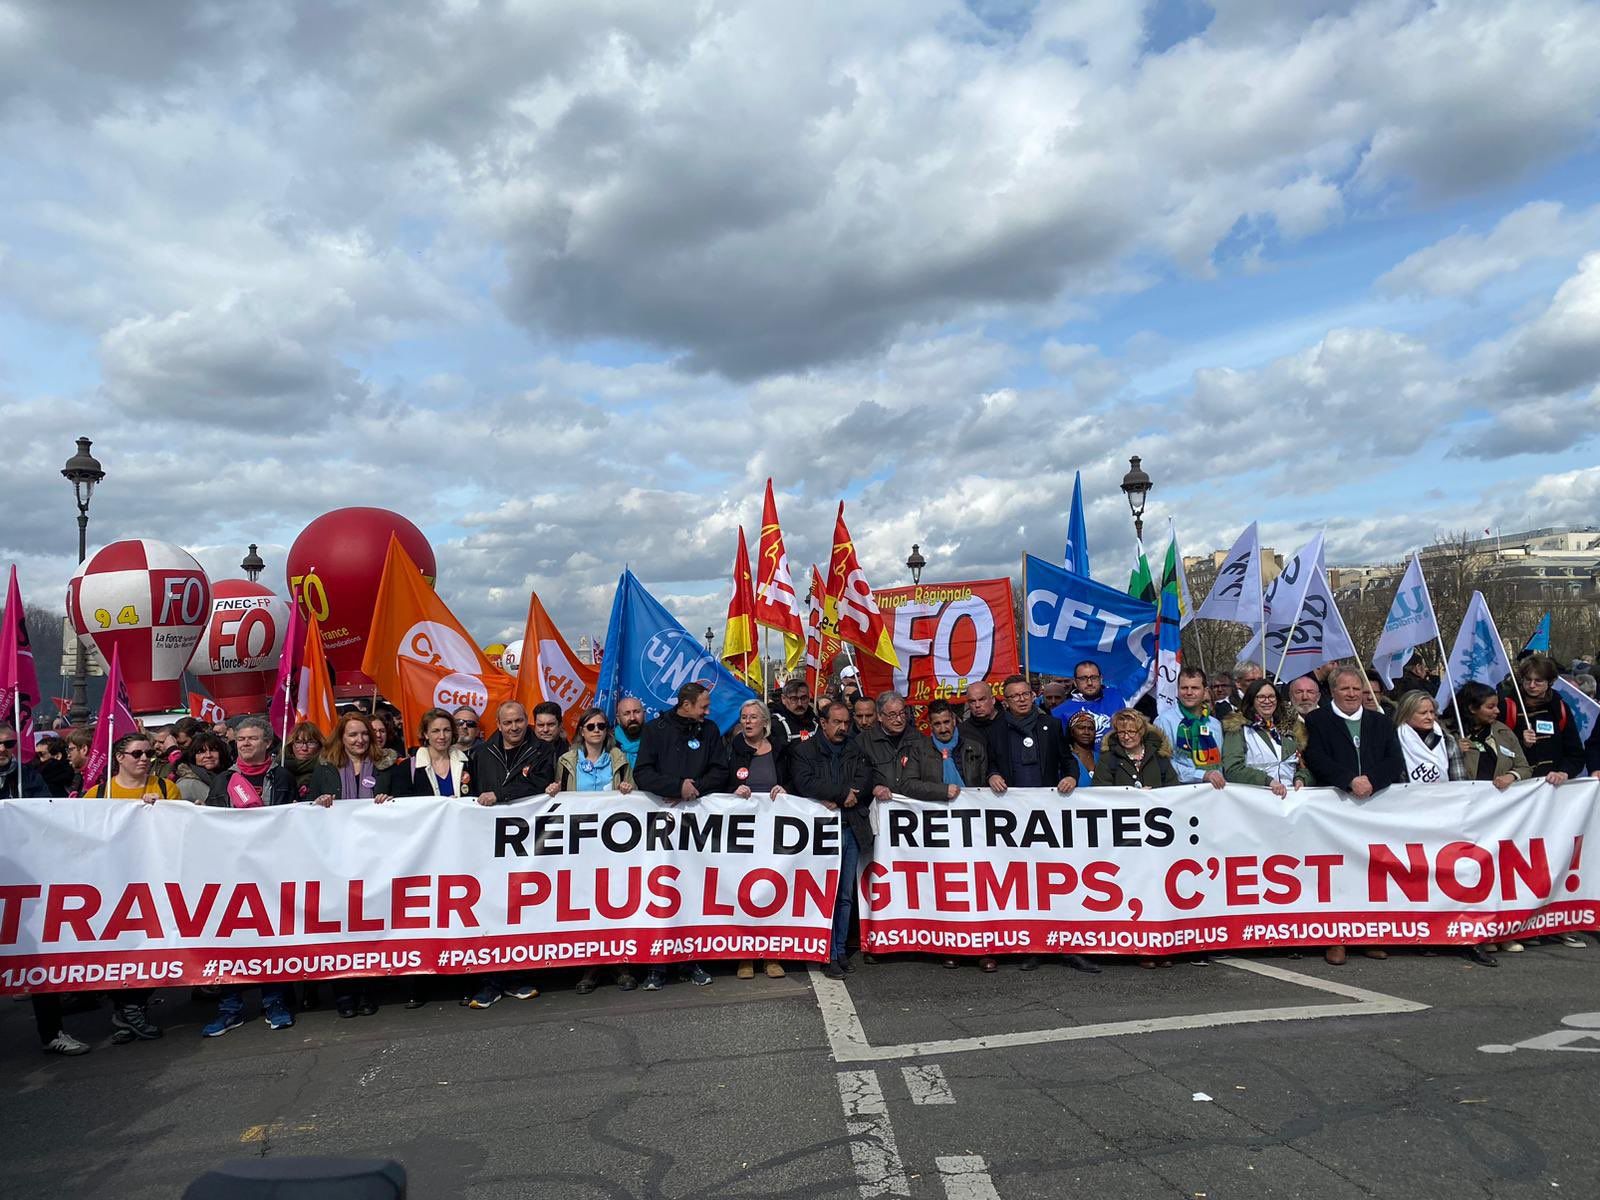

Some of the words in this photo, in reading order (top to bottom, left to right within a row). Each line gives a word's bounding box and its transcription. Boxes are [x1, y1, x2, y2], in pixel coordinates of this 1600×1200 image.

[159, 577, 204, 625] FO
[215, 598, 271, 610] FNEC-FP
[914, 586, 972, 606] Régionale
[155, 632, 165, 642] La
[208, 608, 276, 671] FO
[893, 594, 995, 698] FO
[221, 656, 241, 669] force
[934, 678, 953, 700] de
[201, 698, 225, 724] FO
[1411, 762, 1428, 781] CFE
[1422, 765, 1439, 783] CGC
[494, 803, 756, 857] RÉFORME
[888, 807, 1175, 848] RETRAITES
[0, 874, 482, 946] TRAVAILLER
[506, 865, 682, 925] PLUS
[1164, 854, 1344, 911] C'EST
[1367, 837, 1552, 904] NON
[202, 950, 422, 977] #PAS1JOURDEPLUS
[437, 939, 638, 967] #PAS1JOURDEPLUS
[649, 936, 828, 956] #PAS1JOURDEPLUS
[1045, 927, 1229, 948] #PAS1JOURDEPLUS
[1242, 921, 1431, 941] #PAS1JOURDEPLUS
[1446, 909, 1595, 938] #PAS1JOURDEPLUS
